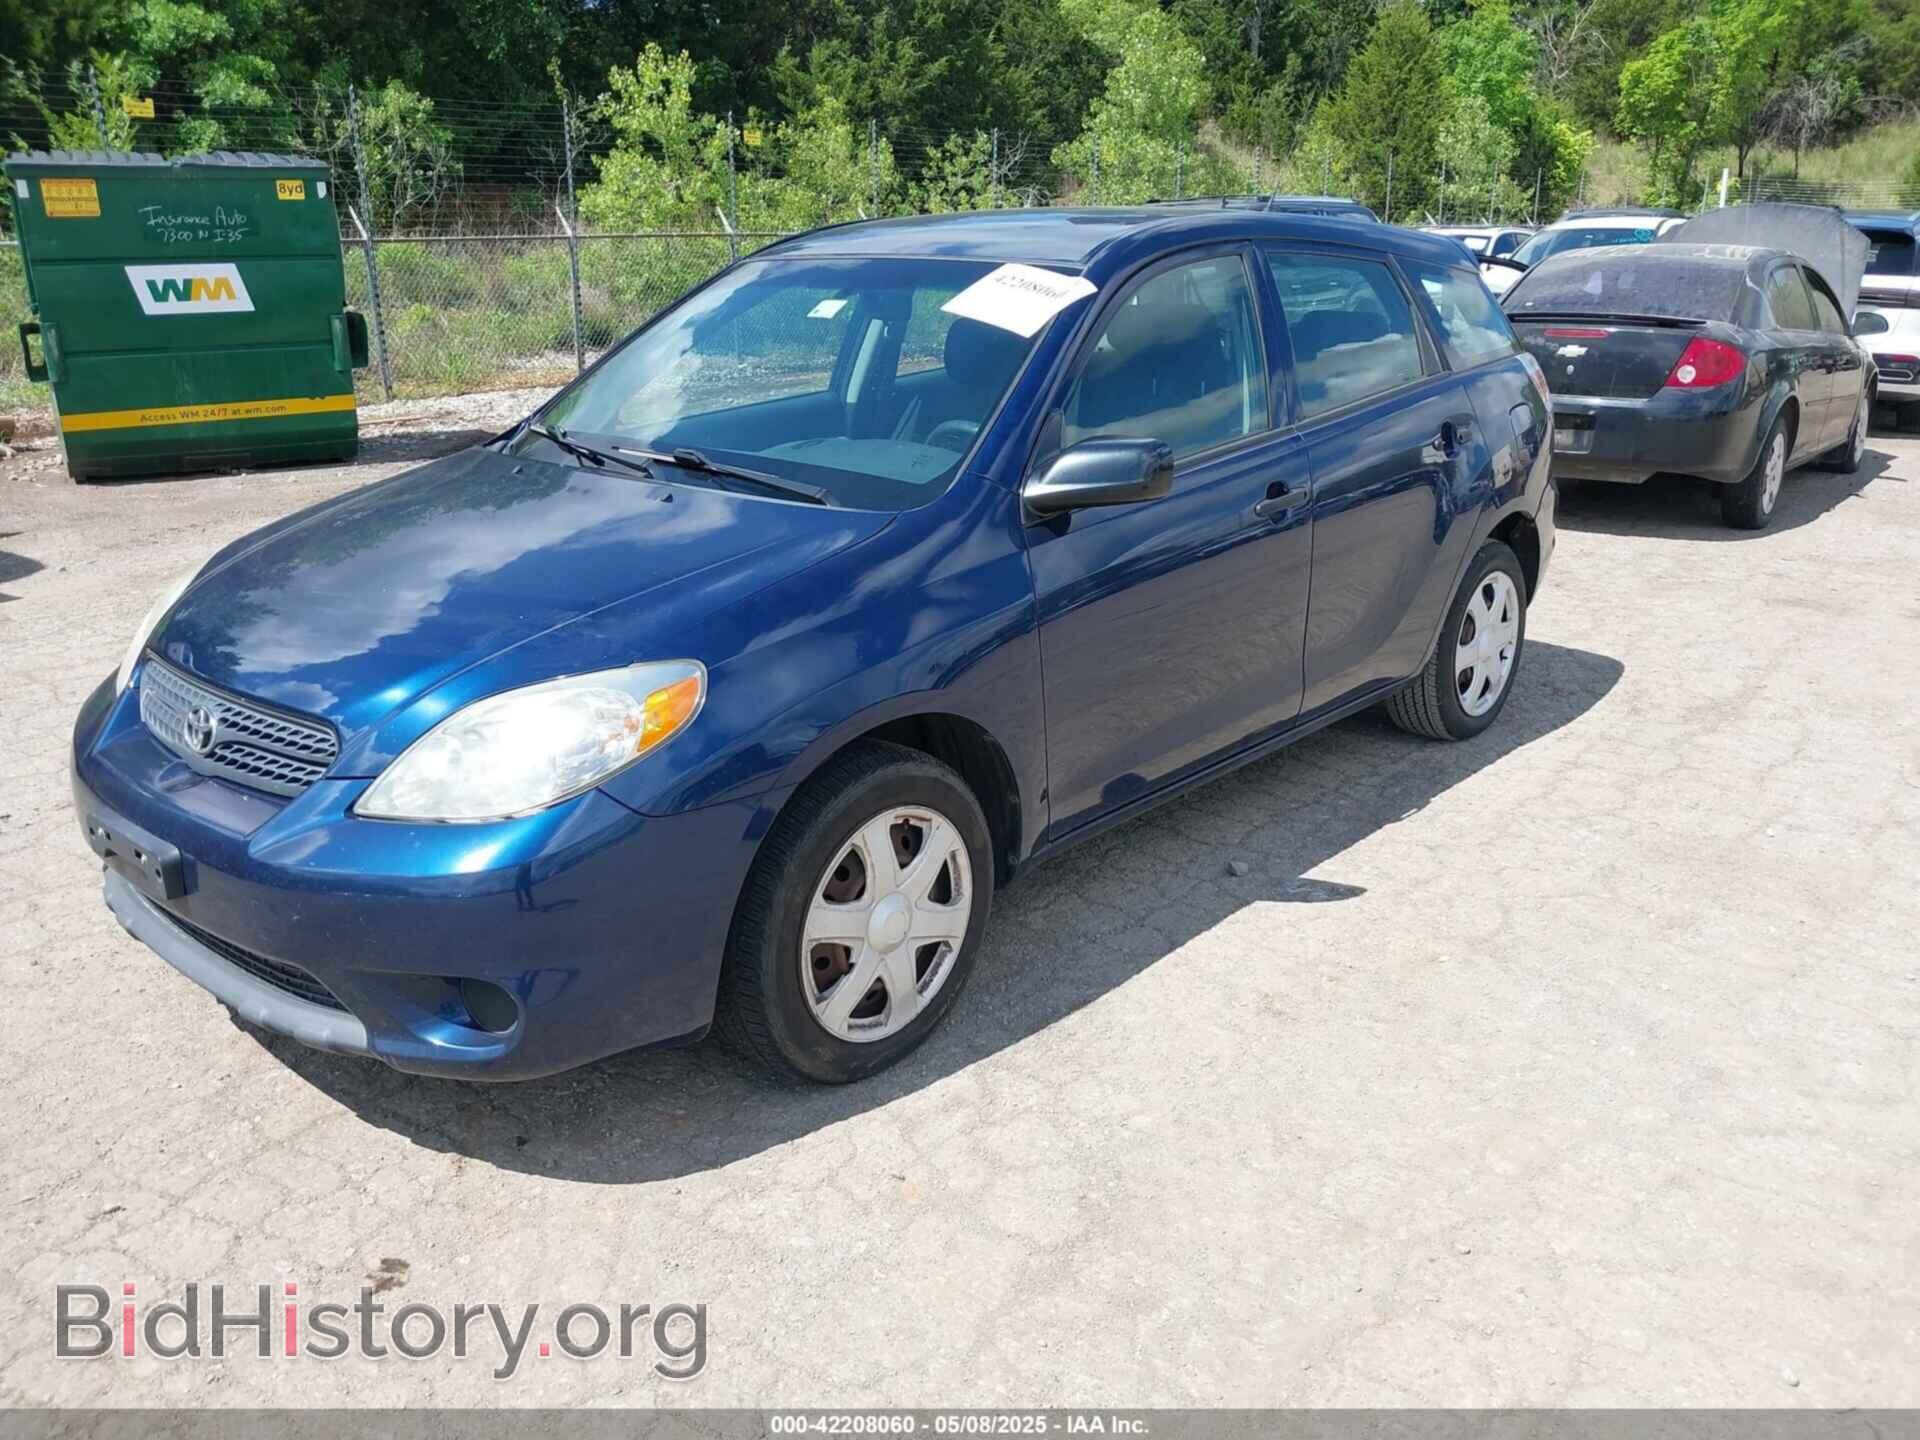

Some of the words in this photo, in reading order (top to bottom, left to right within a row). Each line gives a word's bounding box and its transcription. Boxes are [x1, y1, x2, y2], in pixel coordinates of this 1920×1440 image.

[279, 183, 304, 197] 8yd
[138, 205, 210, 226] Insurance
[215, 206, 247, 226] Auto
[157, 228, 192, 243] 7300
[145, 277, 237, 303] WM
[140, 413, 177, 423] Access
[179, 409, 199, 419] WM
[203, 407, 227, 417] 24/7
[231, 407, 241, 416] at
[245, 405, 287, 415] wm.com
